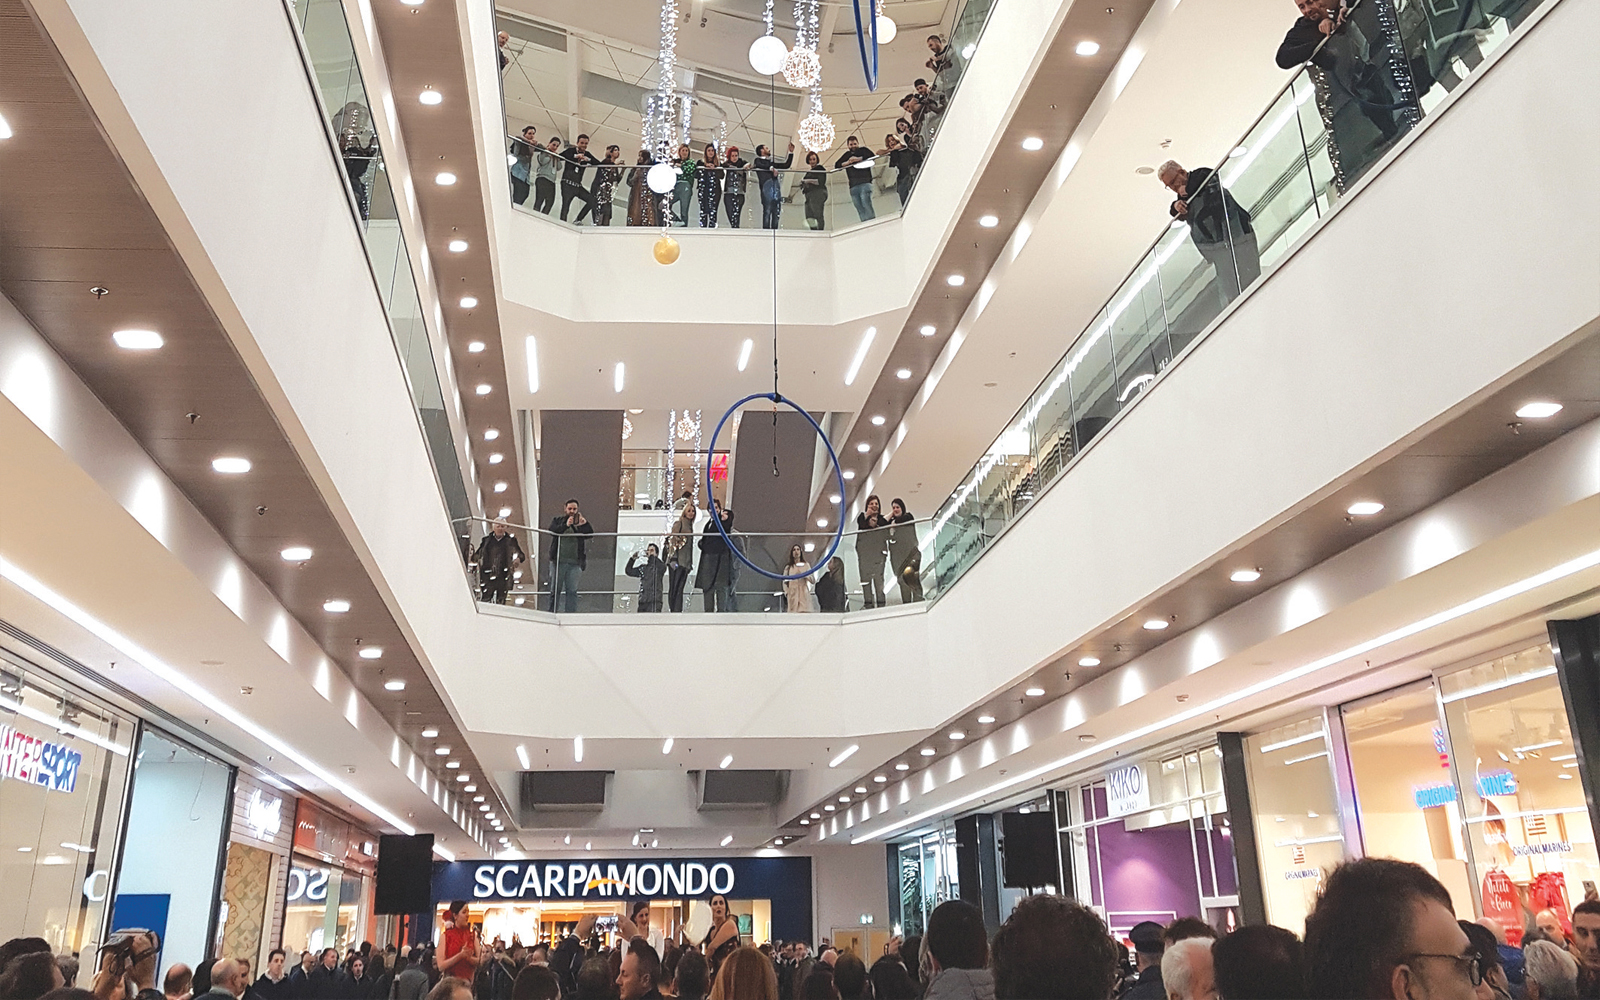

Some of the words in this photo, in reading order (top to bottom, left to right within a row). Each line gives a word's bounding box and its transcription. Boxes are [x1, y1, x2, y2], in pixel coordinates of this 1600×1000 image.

[1109, 766, 1141, 801] KIKO
[1512, 844, 1542, 856] ORIGINAL
[1542, 841, 1571, 853] MARINES
[473, 863, 735, 898] SCARPAMONDO
